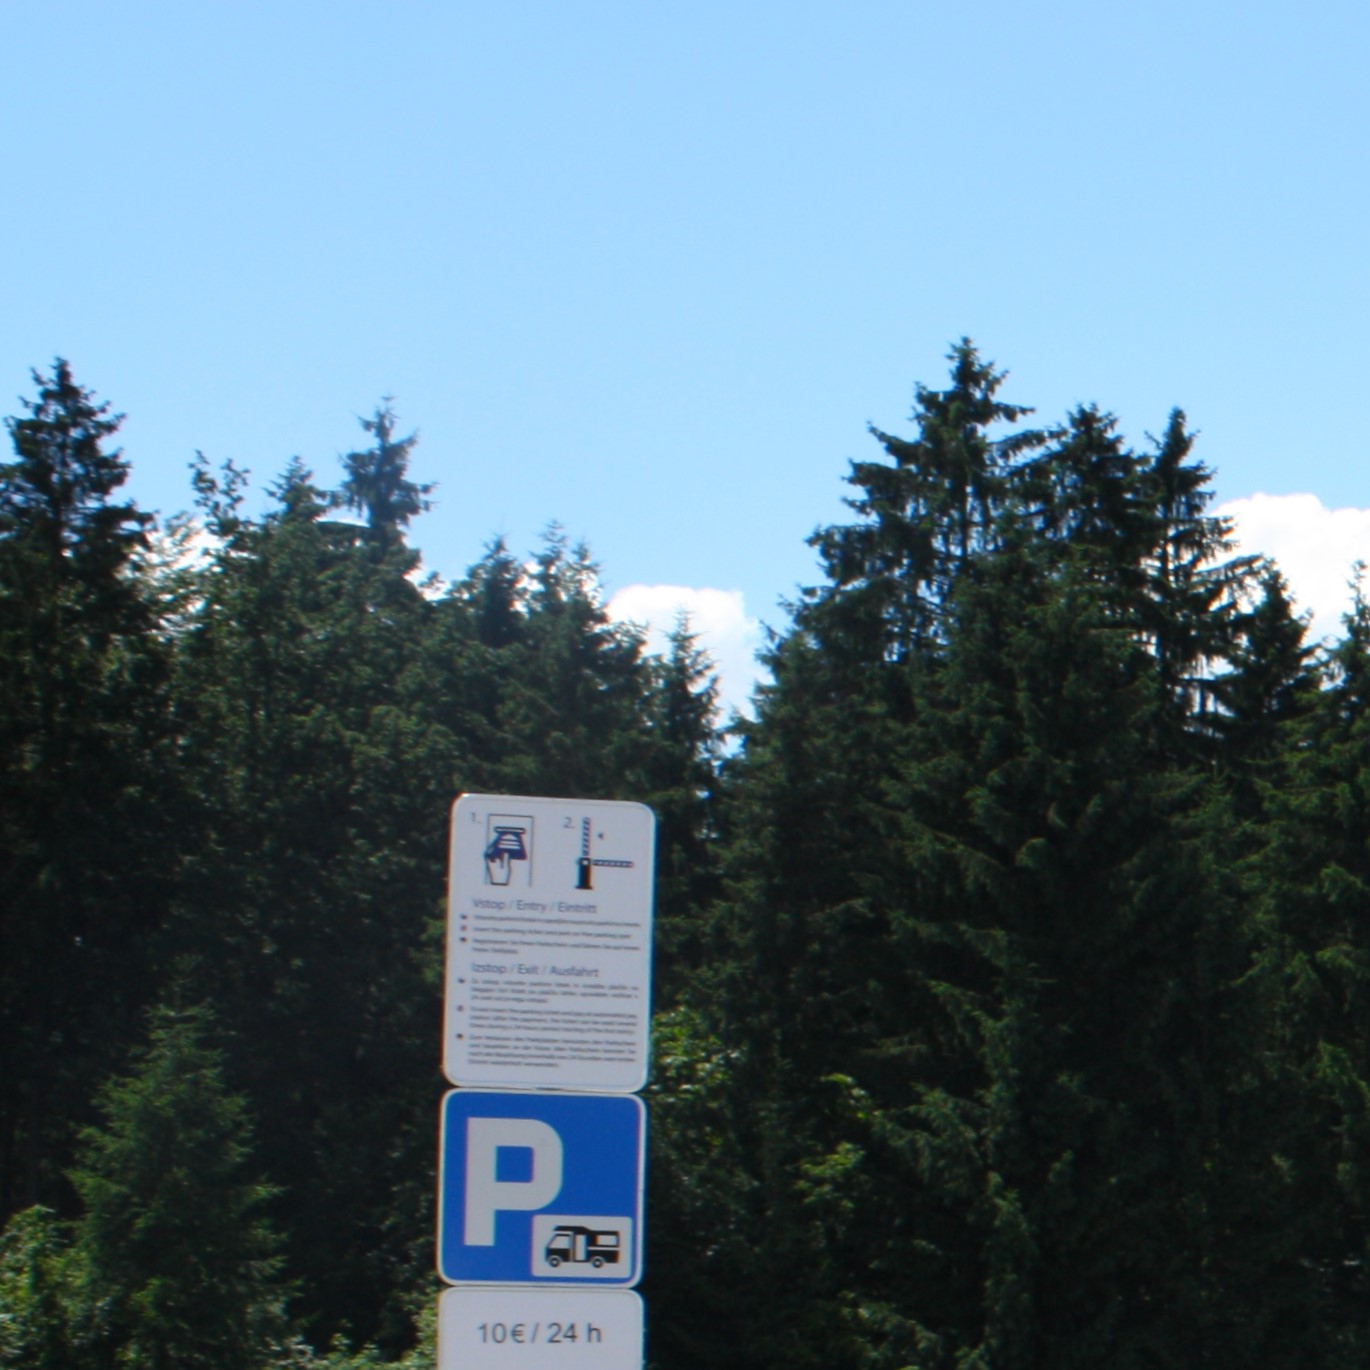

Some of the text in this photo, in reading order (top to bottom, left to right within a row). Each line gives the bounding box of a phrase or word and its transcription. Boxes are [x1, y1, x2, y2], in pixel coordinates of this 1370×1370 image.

[470, 812, 482, 825] 1.
[563, 816, 576, 829] 2.
[472, 899, 506, 911] Vstop
[516, 899, 547, 913] Entry
[558, 901, 597, 914] Eintritt
[471, 963, 507, 975] Izstop
[518, 964, 539, 975] Exit
[550, 965, 600, 977] Ausfahrt
[463, 1117, 563, 1246] P
[547, 1322, 578, 1343] 24
[588, 1322, 602, 1344] h
